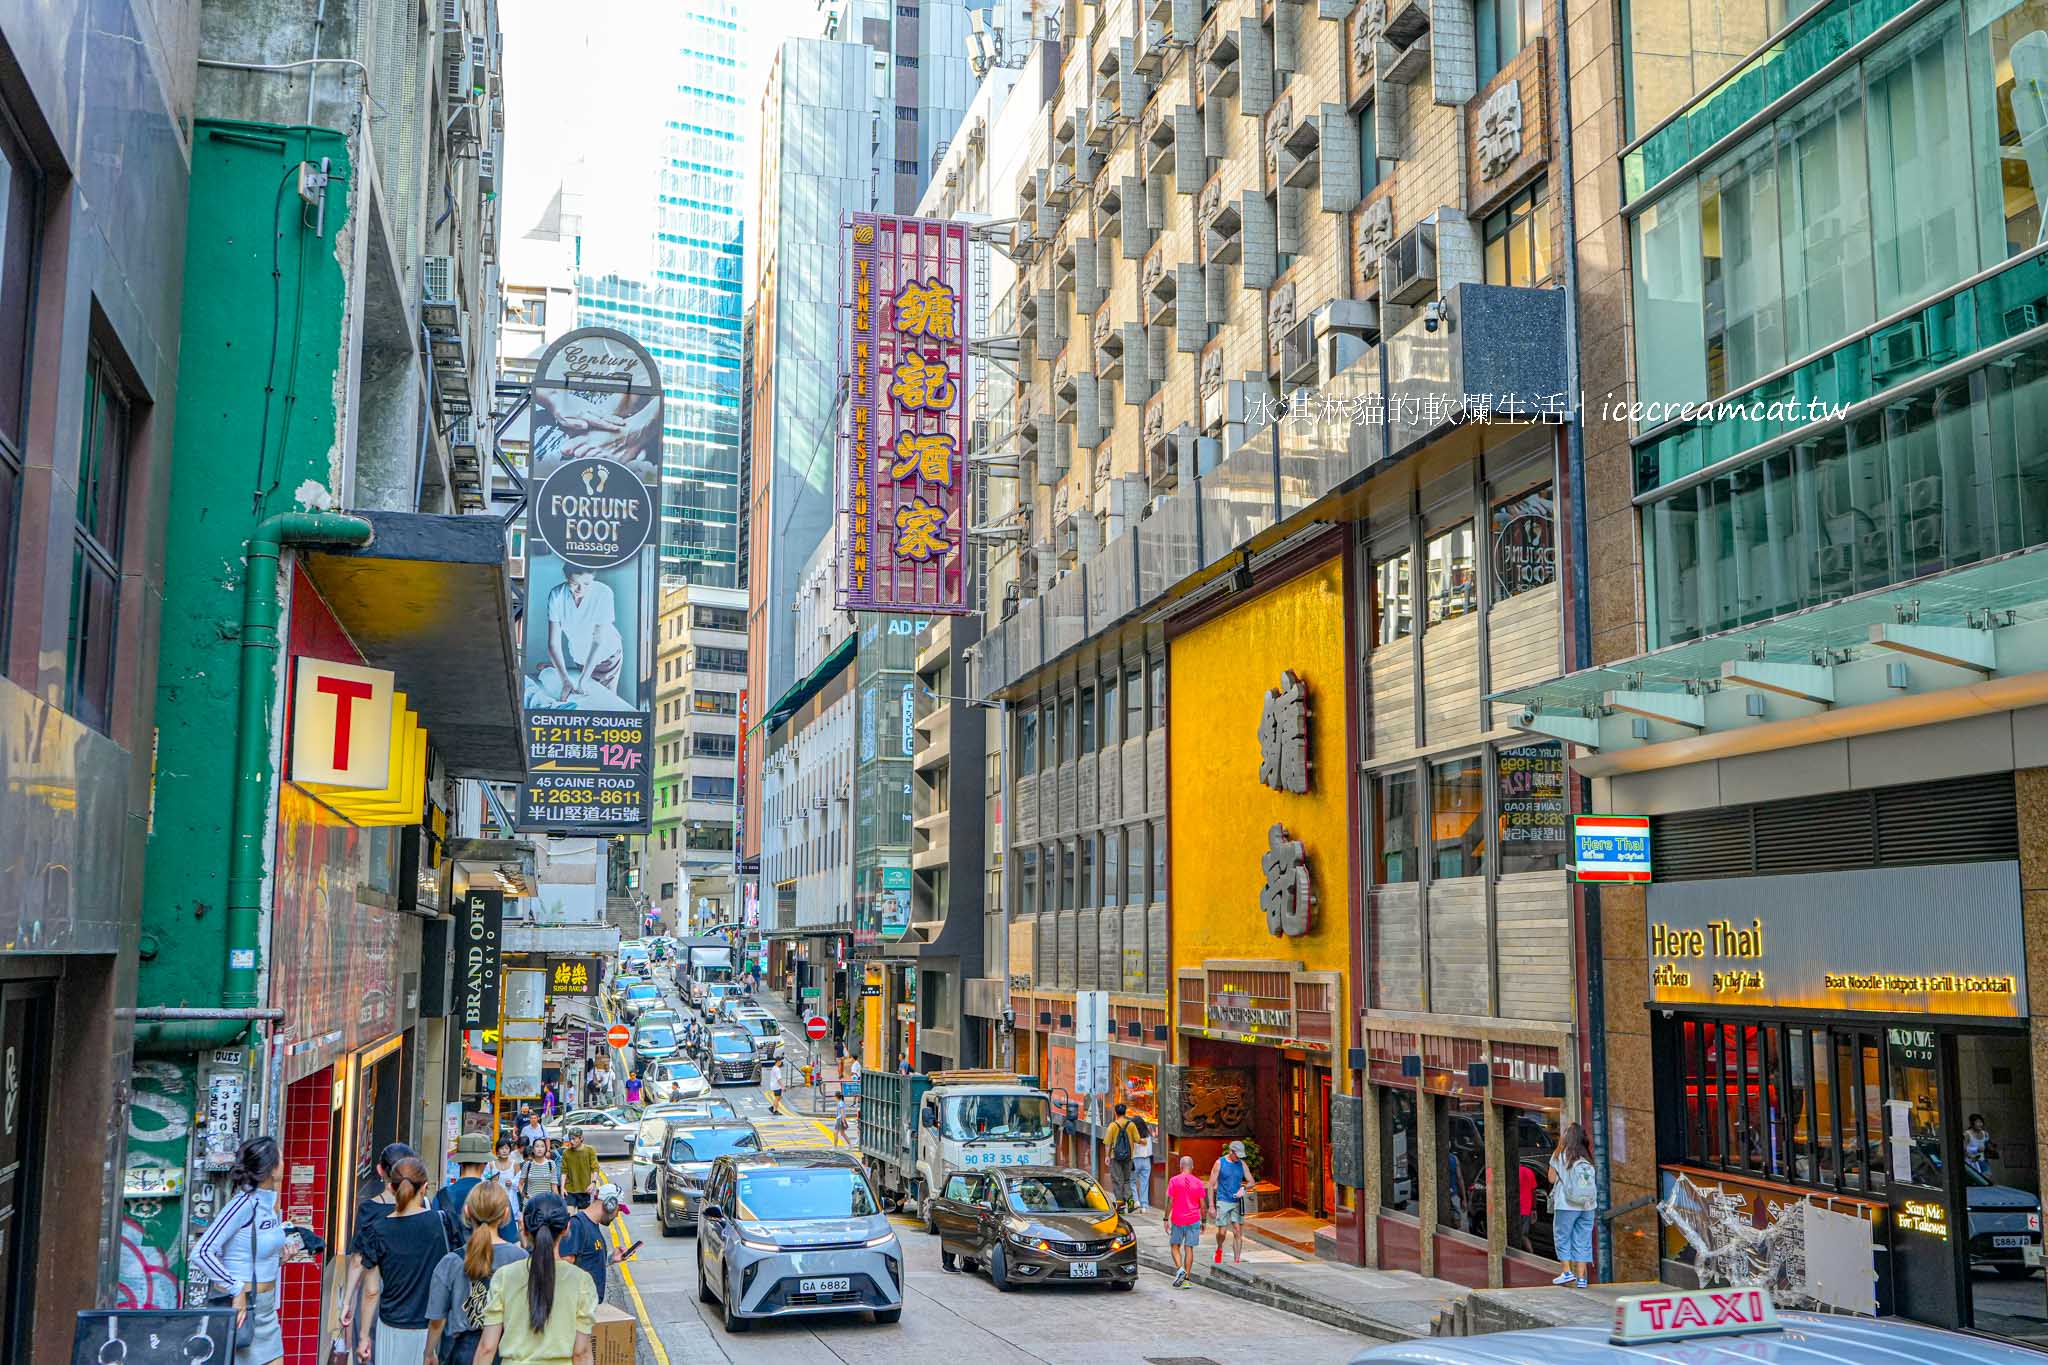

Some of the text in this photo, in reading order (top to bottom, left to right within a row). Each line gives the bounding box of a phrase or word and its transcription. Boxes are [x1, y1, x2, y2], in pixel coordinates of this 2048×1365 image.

[564, 346, 640, 368] Century
[855, 260, 871, 592] YUNG KEE RESTAURANT
[890, 278, 957, 561] 鏞記酒家
[551, 495, 640, 521] FORTUNE
[565, 519, 621, 542] FOOT
[566, 540, 619, 555] massage
[317, 676, 373, 771] T
[531, 715, 643, 728] CENTURY SQUARE
[531, 727, 642, 743] T: 2115-1999
[530, 743, 642, 769] 世紀廣場 12/F
[536, 777, 635, 789] 45 CAINE ROAD
[529, 788, 640, 805] T: 2633-8611
[528, 806, 641, 822] 半山堅道45號
[1581, 837, 1645, 851] Here Thai
[1652, 918, 1762, 957] Here Thai
[466, 896, 486, 1024] BRAND OFF
[484, 931, 495, 989] TOKYO
[1825, 975, 1846, 988] Boat
[1848, 975, 1882, 989] Noodle
[1884, 976, 1919, 993] Hotpot
[1930, 976, 1952, 991] Grill
[1965, 977, 2013, 993] Cocktail
[965, 1155, 978, 1164] 90
[983, 1153, 996, 1162] 83
[1000, 1155, 1013, 1164] 35
[1072, 1269, 1096, 1278] 3386
[1078, 1262, 1089, 1270] MV
[803, 1280, 847, 1291] GA 6882
[1640, 1291, 1764, 1331] TAXI
